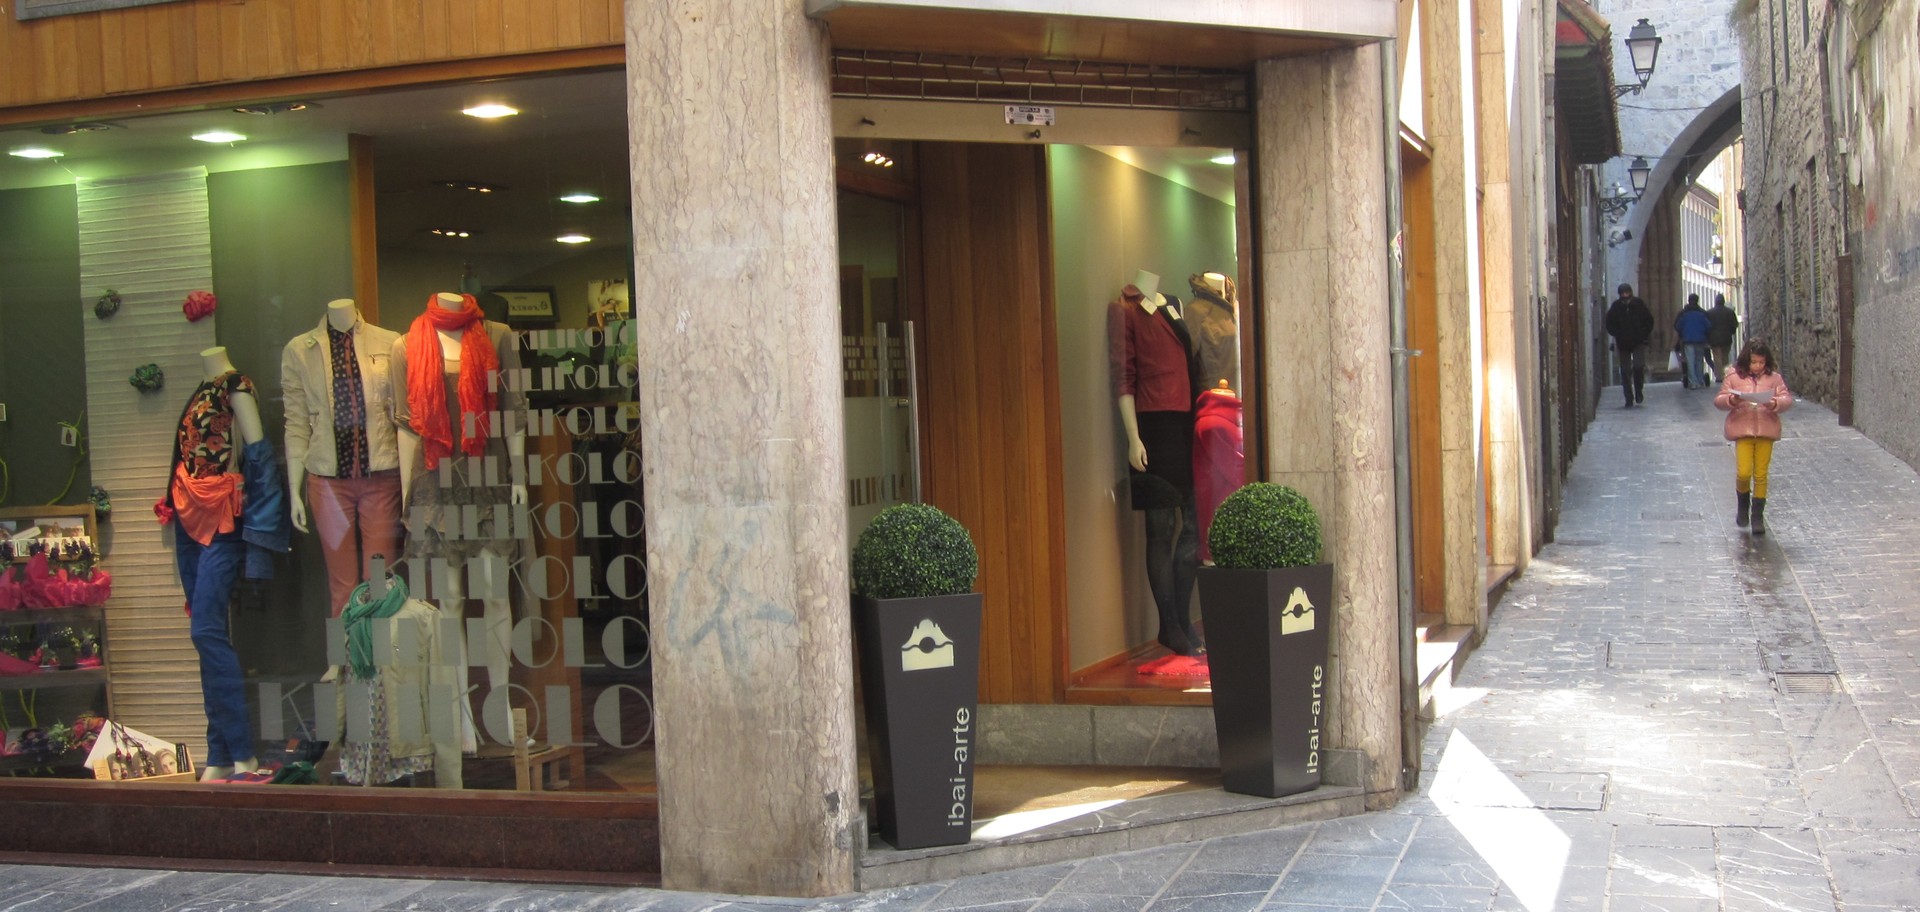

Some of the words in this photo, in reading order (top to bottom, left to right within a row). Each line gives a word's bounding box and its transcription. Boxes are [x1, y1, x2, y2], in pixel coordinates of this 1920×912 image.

[511, 326, 637, 350] KILIKOLO
[488, 363, 639, 393] KILIKOLO
[464, 405, 641, 438] KILIKOLO
[439, 450, 644, 488] KILIKOLO
[410, 500, 646, 541] KILIKOLO
[370, 554, 648, 601] KILIKOLO
[326, 616, 651, 668] KILIKOLO
[259, 682, 653, 750] KILIKOLO
[1306, 664, 1323, 774] ibai-arte
[947, 706, 970, 827] ibai-arte
